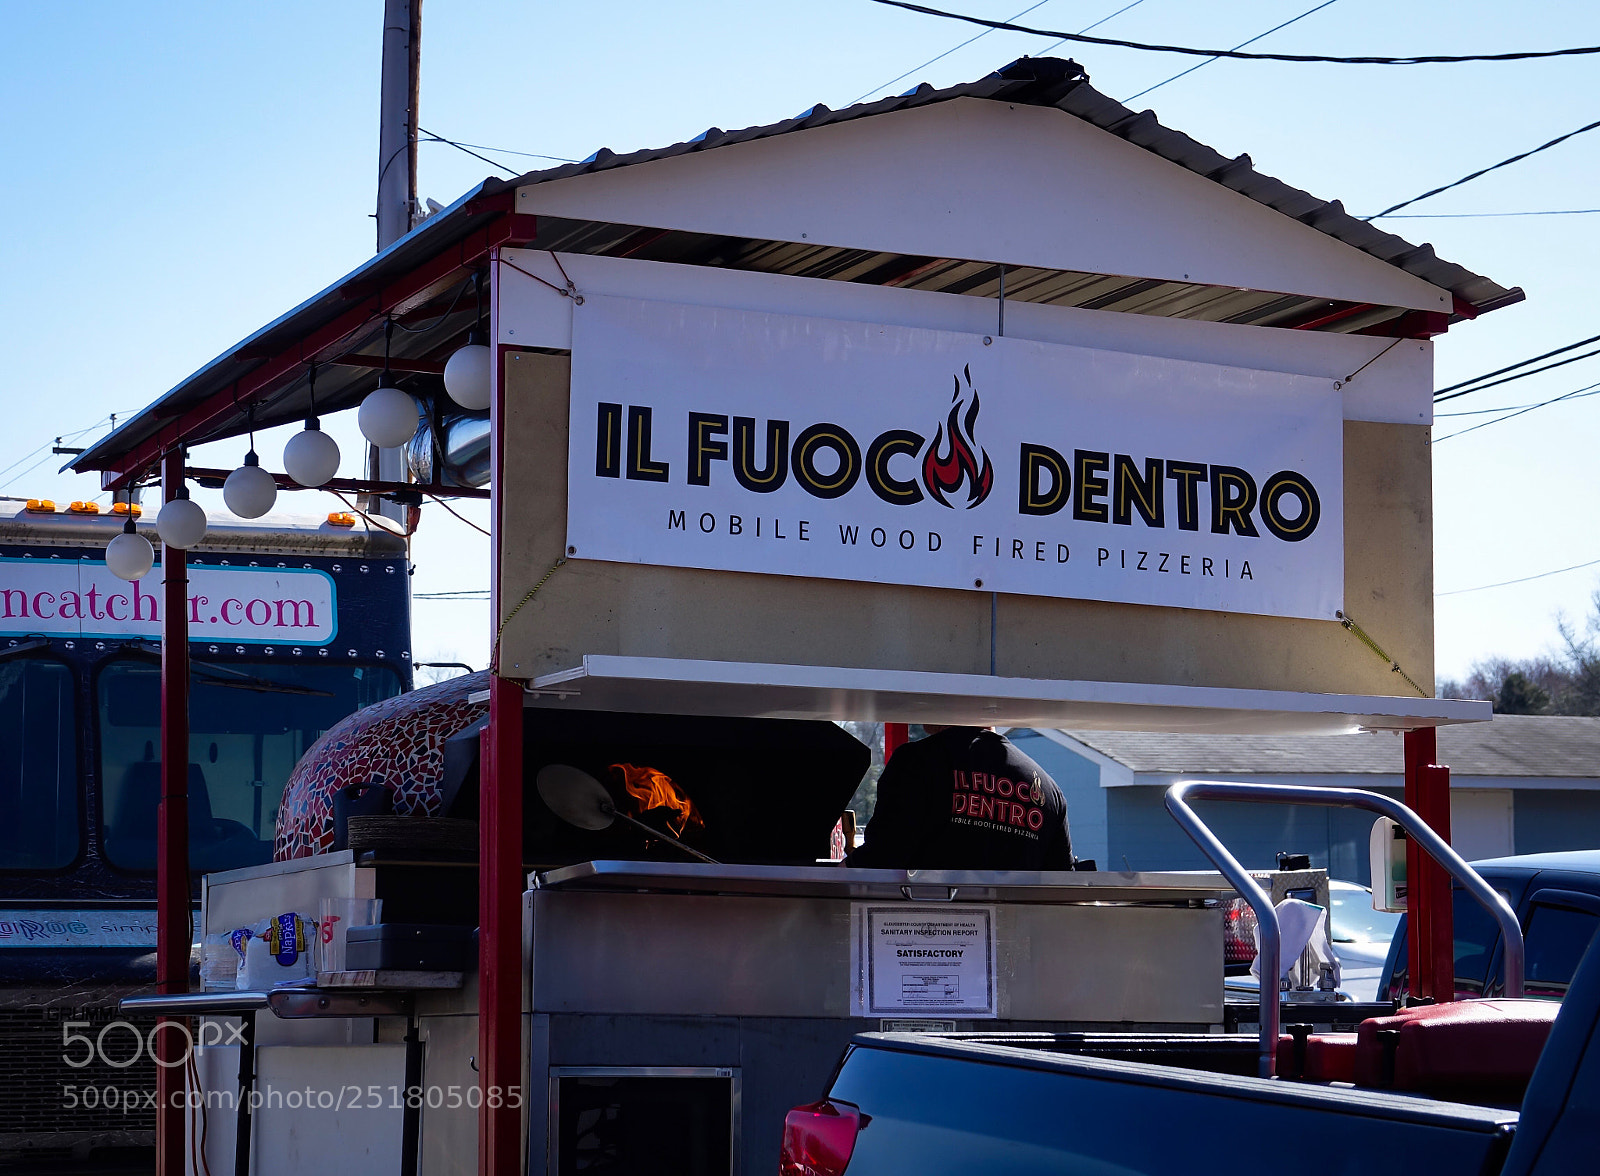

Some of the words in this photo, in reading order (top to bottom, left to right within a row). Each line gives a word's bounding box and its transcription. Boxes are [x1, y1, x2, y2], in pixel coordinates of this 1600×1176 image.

[596, 402, 670, 482] IL
[1019, 442, 1322, 542] DENTRO
[667, 509, 812, 542] MOBILE
[839, 524, 943, 553] WOOD
[973, 535, 1072, 565] FIRED
[1098, 547, 1256, 581] PIZZERIA
[1, 579, 320, 628] ncatchr.com
[953, 770, 970, 790] IL
[952, 792, 1045, 832] DENTRO
[896, 949, 964, 958] SATISFACTORY
